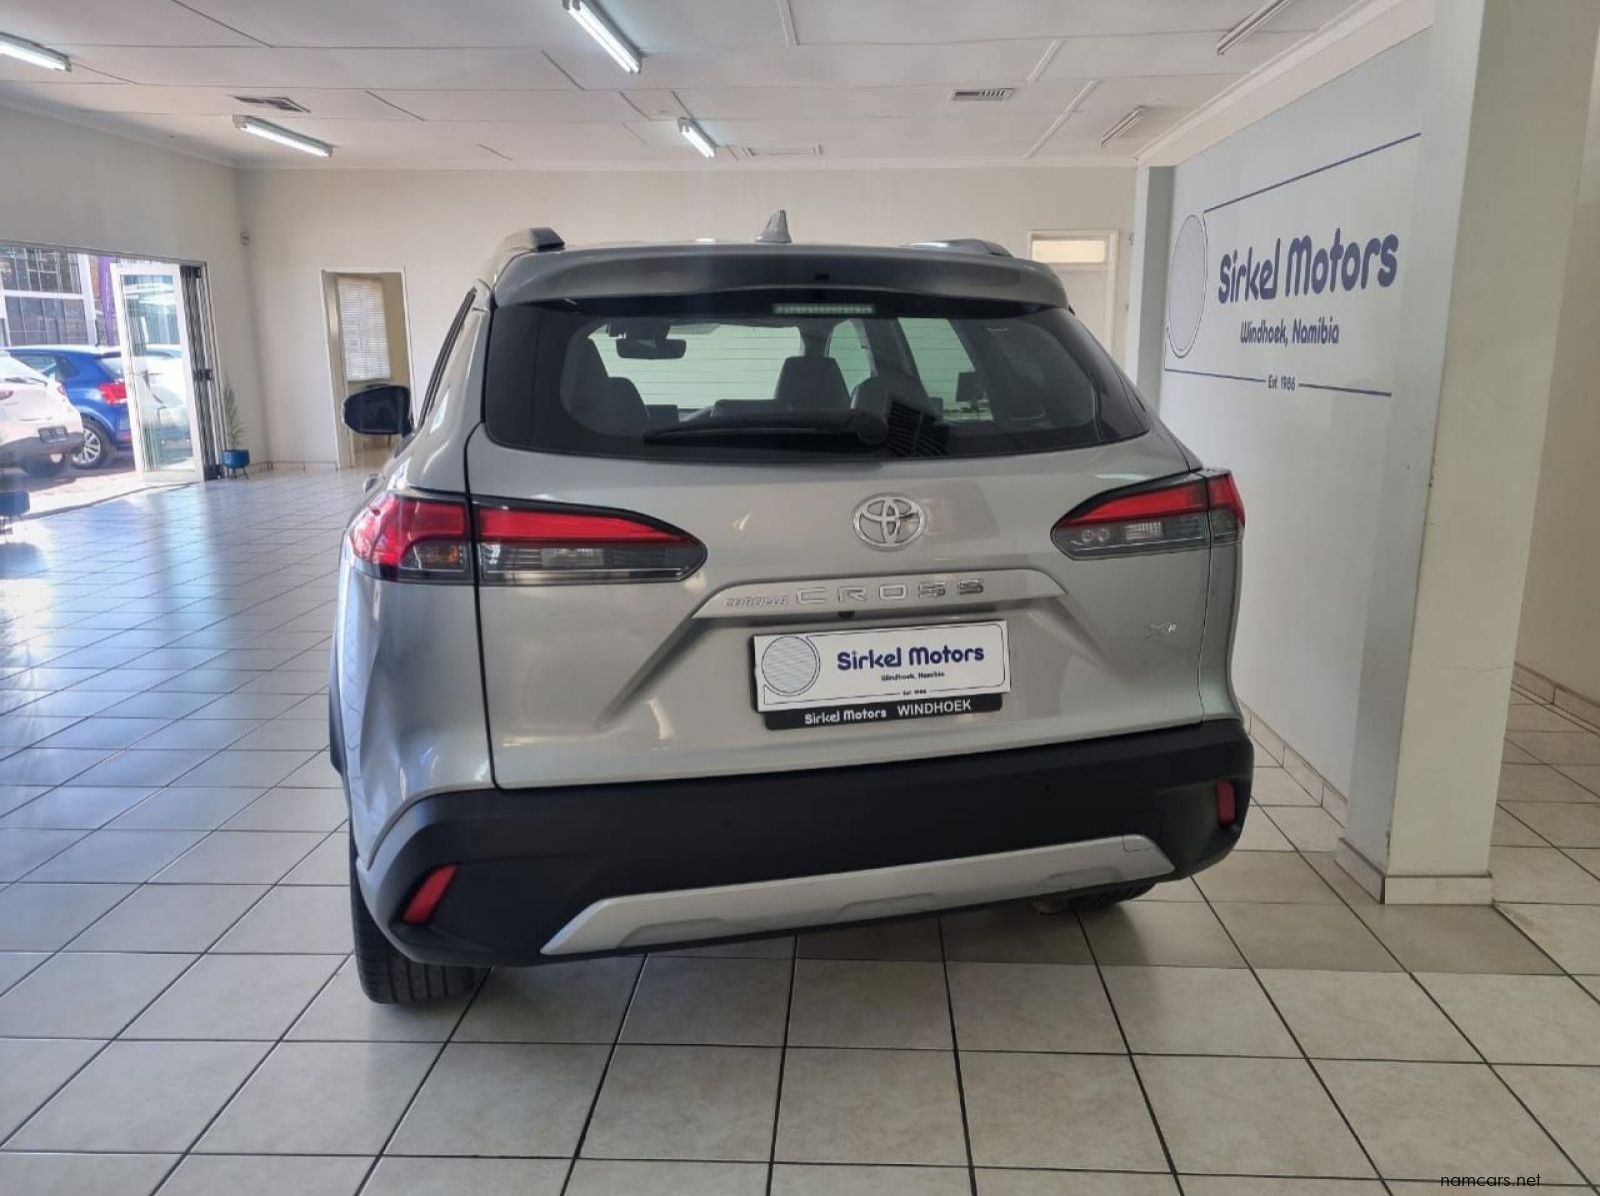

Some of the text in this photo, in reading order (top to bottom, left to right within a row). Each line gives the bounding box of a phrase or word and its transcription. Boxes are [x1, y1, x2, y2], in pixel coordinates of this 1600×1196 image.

[1218, 228, 1399, 304] Sirkel Motors
[1240, 316, 1340, 348] Windhoek, Namibia
[797, 578, 984, 604] CROSS
[837, 645, 985, 671] Sirkel Motors
[804, 699, 972, 725] Sirkel Motors WINDHOEK
